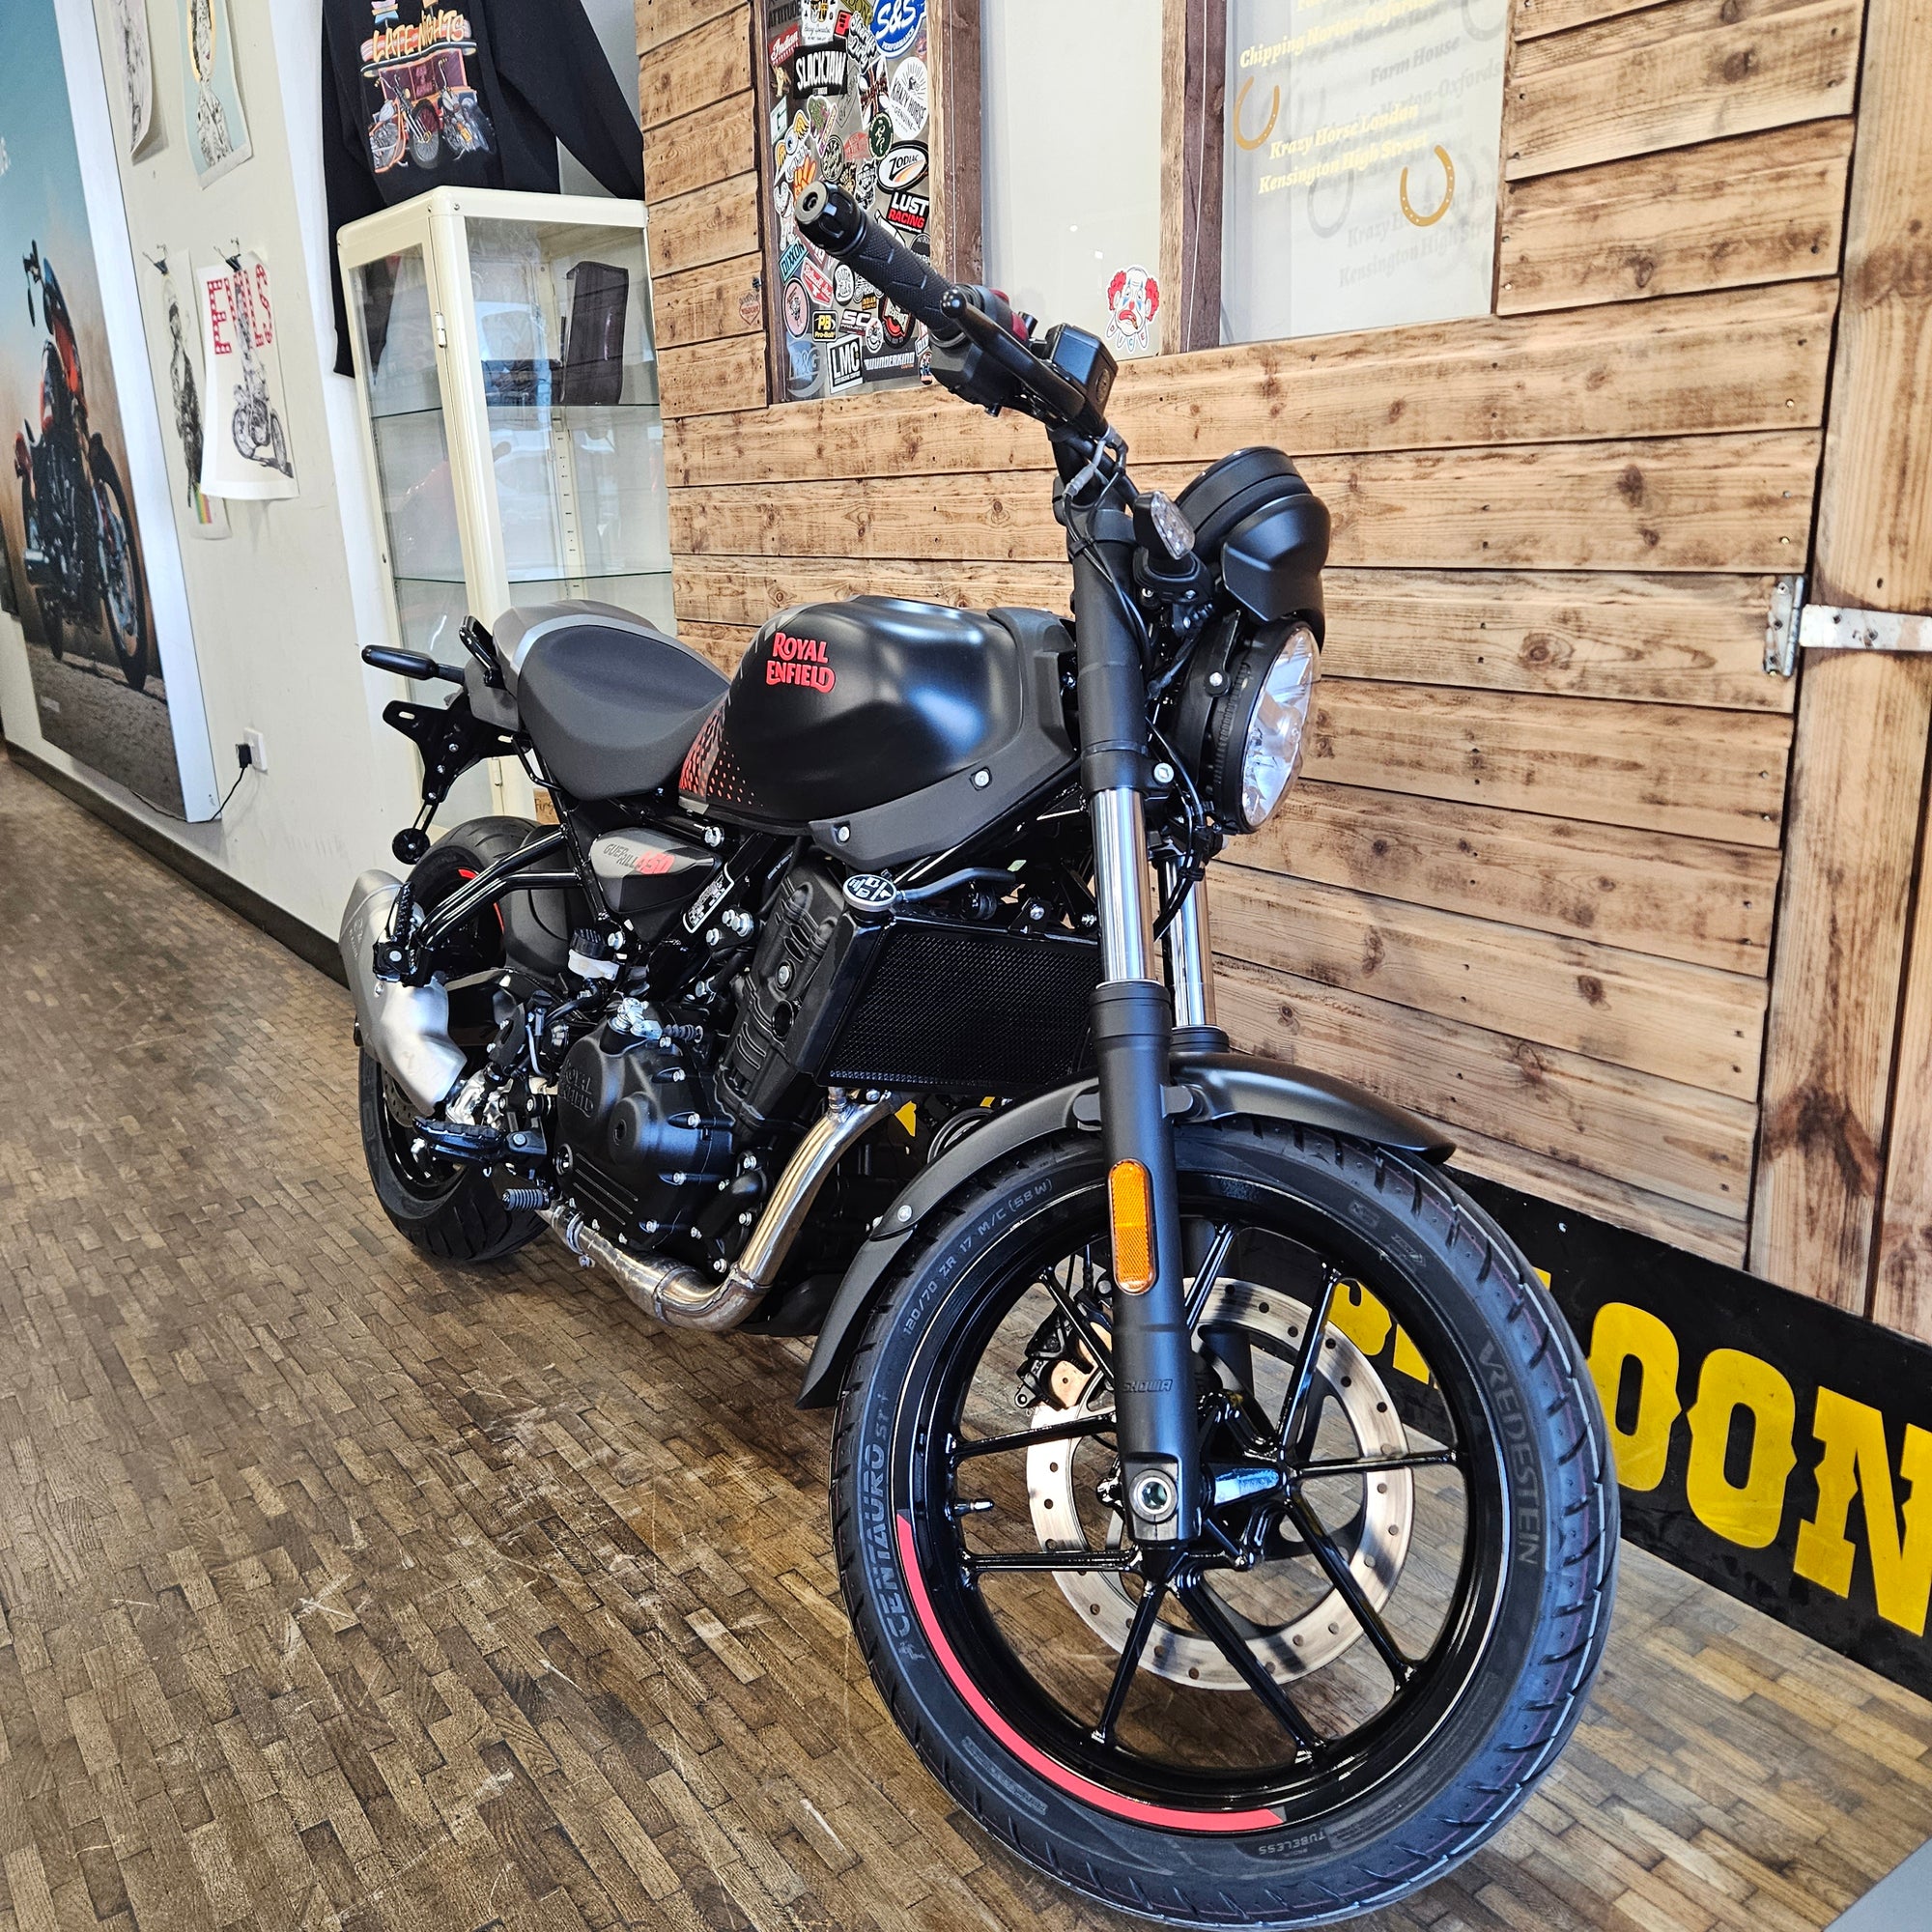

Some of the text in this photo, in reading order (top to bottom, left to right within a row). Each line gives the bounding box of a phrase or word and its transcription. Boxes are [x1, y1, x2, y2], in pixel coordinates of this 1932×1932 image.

[373, 24, 415, 63] LATE
[771, 31, 799, 62] Indian
[1239, 36, 1305, 69] Chipping
[796, 50, 846, 90] SLACKJAW
[1269, 102, 1419, 160] Krazy Horse London
[889, 154, 920, 182] ZODIAC
[1258, 130, 1430, 194] Kensington High Street
[888, 208, 925, 229] RACING
[891, 192, 929, 215] LUST
[781, 242, 806, 276] DIXXON
[817, 314, 832, 330] PB
[841, 311, 871, 327] SC
[832, 341, 860, 378] LMC
[773, 632, 829, 664] ROYAL
[766, 660, 836, 694] ENFIELD
[902, 1280, 938, 1335] 120/70
[938, 1256, 957, 1277] ZR
[959, 1236, 973, 1253] 17
[978, 1208, 1008, 1236] M/C
[1122, 1378, 1174, 1394] SHOWA
[1475, 1339, 1543, 1565] VREDESTEIN
[862, 1443, 911, 1638] CENTAURO
[1258, 1831, 1328, 1855] TUBELESS
